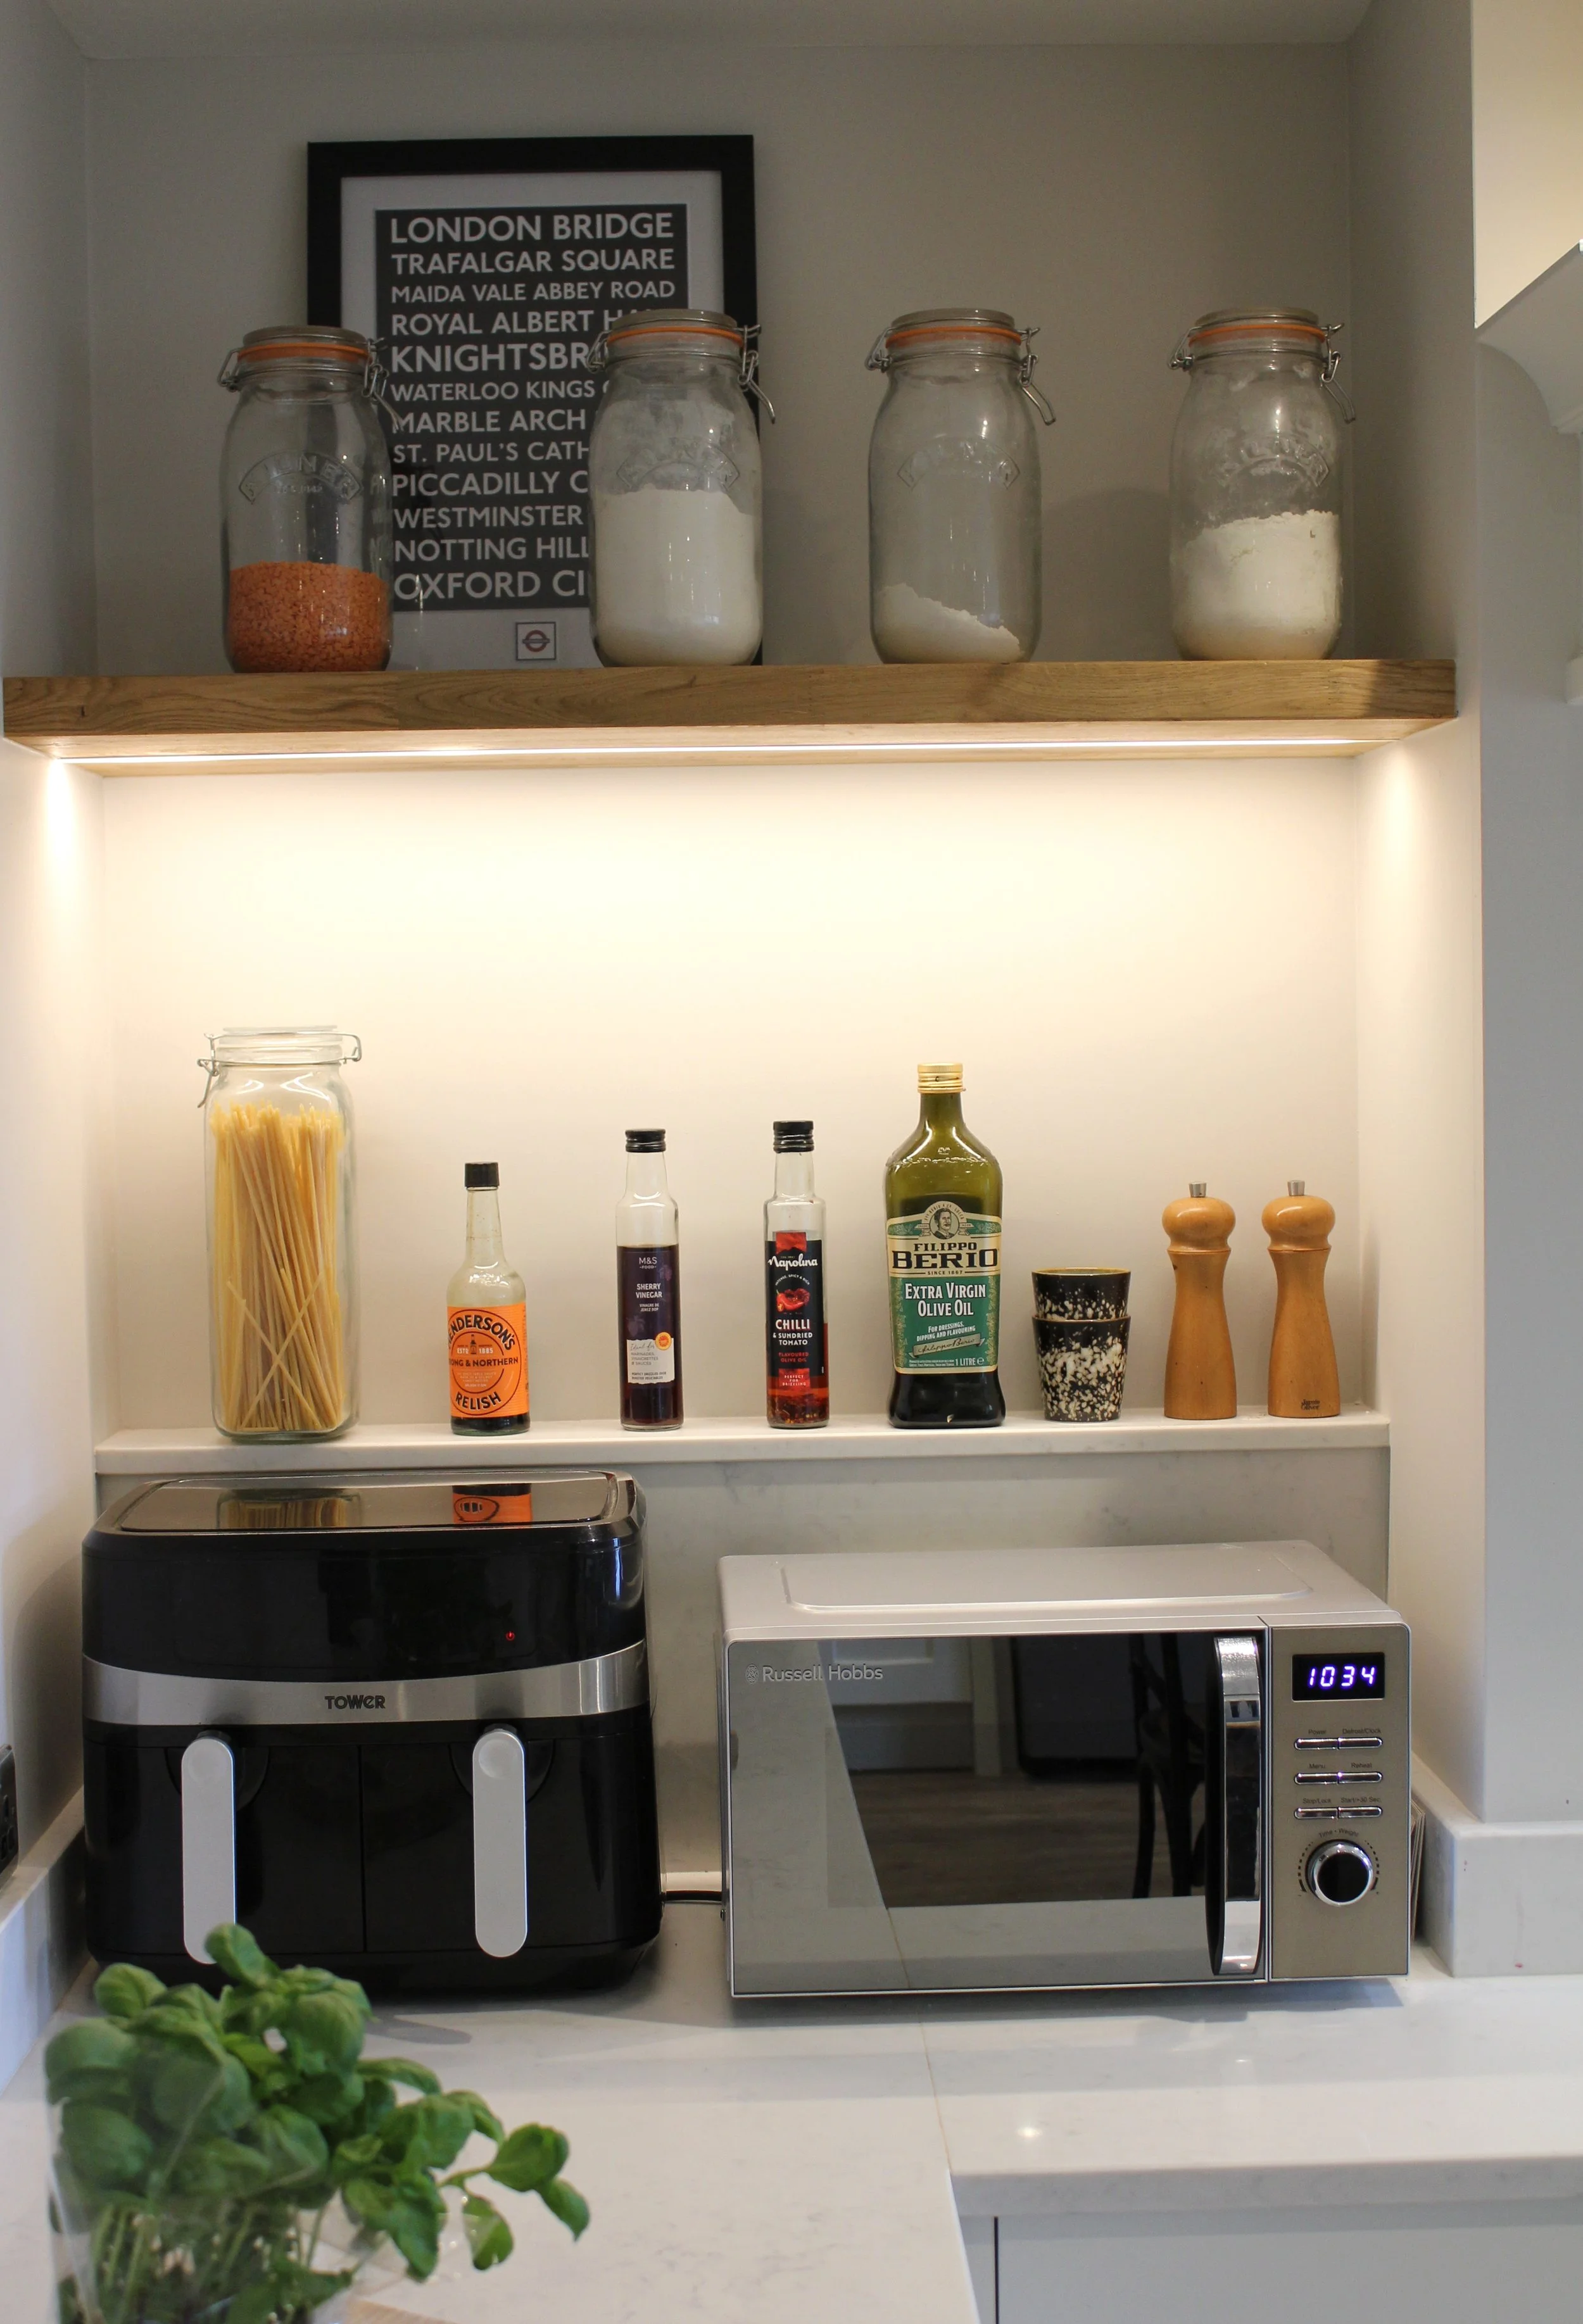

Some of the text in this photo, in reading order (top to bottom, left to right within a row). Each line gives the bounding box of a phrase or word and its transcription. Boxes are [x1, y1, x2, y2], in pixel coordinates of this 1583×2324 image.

[390, 212, 674, 244] LONDON BRIDGE
[391, 248, 676, 275] TRAFALGAR SQUARE
[391, 280, 676, 303] MAIDA VALE ABBEY ROAD
[391, 313, 483, 337] ROYAL
[491, 310, 594, 334] ALBERT
[389, 381, 519, 402] WATERLOO
[526, 380, 595, 399] KINGS
[391, 408, 586, 434] MARBLE ARCH
[392, 443, 427, 464] ST.
[436, 442, 519, 462] PAUL'S
[392, 470, 560, 497] PICCADILLY
[393, 505, 583, 529] WESTMINSTER
[394, 536, 589, 562] NOTTING HILL
[394, 570, 541, 601] OXFORD
[914, 1241, 977, 1252] FILIPPO
[639, 1257, 657, 1265] M&S
[767, 1253, 818, 1271] Napolina
[892, 1248, 998, 1269] BERIO
[802, 1278, 810, 1286] RICH
[905, 1282, 987, 1300] EXTRA VIRGIN
[918, 1298, 974, 1317] OLIVE OIL
[775, 1319, 810, 1330] CHILLI
[916, 1325, 976, 1342] DIPPING AND FLAVOURING
[928, 1325, 938, 1333] FOR
[465, 1359, 471, 1367] &
[472, 1357, 519, 1367] NORTHERN
[960, 1357, 976, 1366] LITRE
[455, 1391, 501, 1410] RELISH
[762, 1663, 884, 1683] Russell Hobbs
[1319, 1828, 1359, 1838] Time Weight
